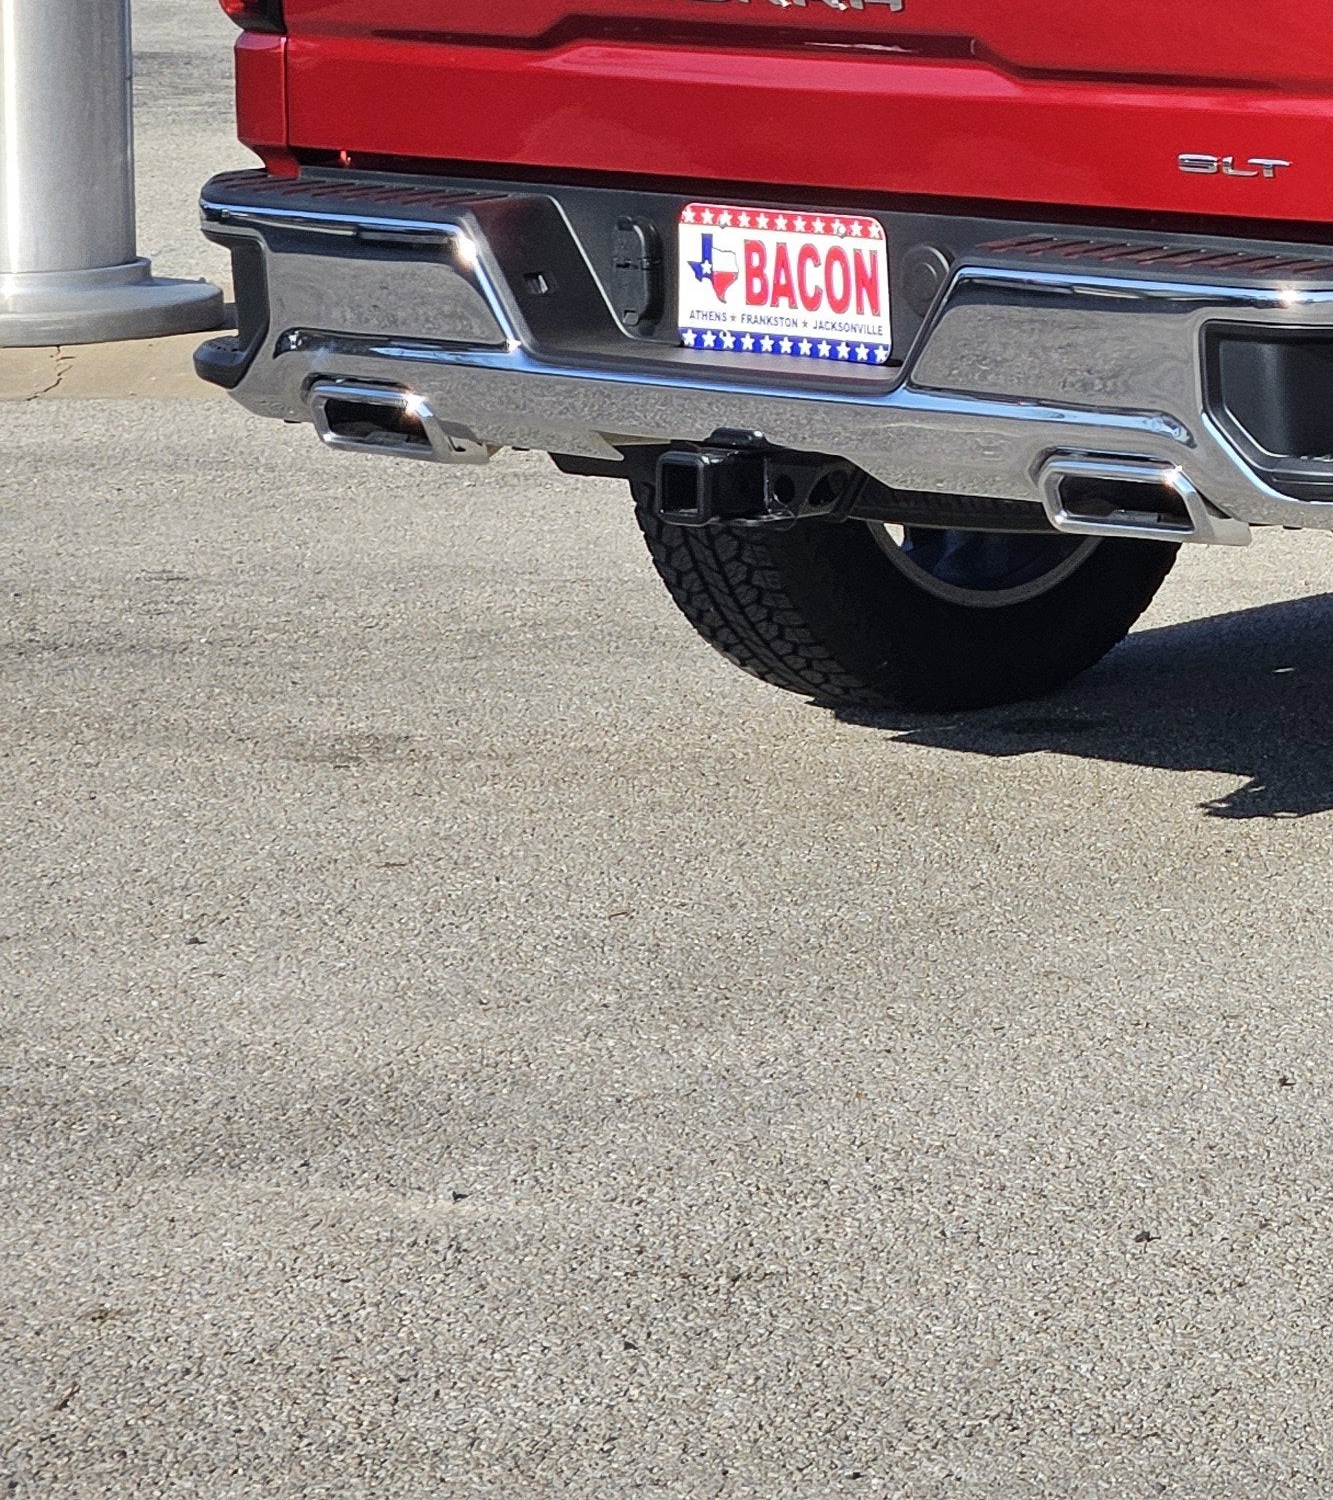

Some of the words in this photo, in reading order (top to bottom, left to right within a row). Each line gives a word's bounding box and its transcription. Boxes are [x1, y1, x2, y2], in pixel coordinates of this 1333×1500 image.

[1178, 153, 1292, 178] SLT
[743, 239, 882, 317] BACON
[689, 309, 727, 323] ATHENS
[740, 313, 798, 328] FRANKSTON
[813, 320, 883, 336] JACKSONVILLE
